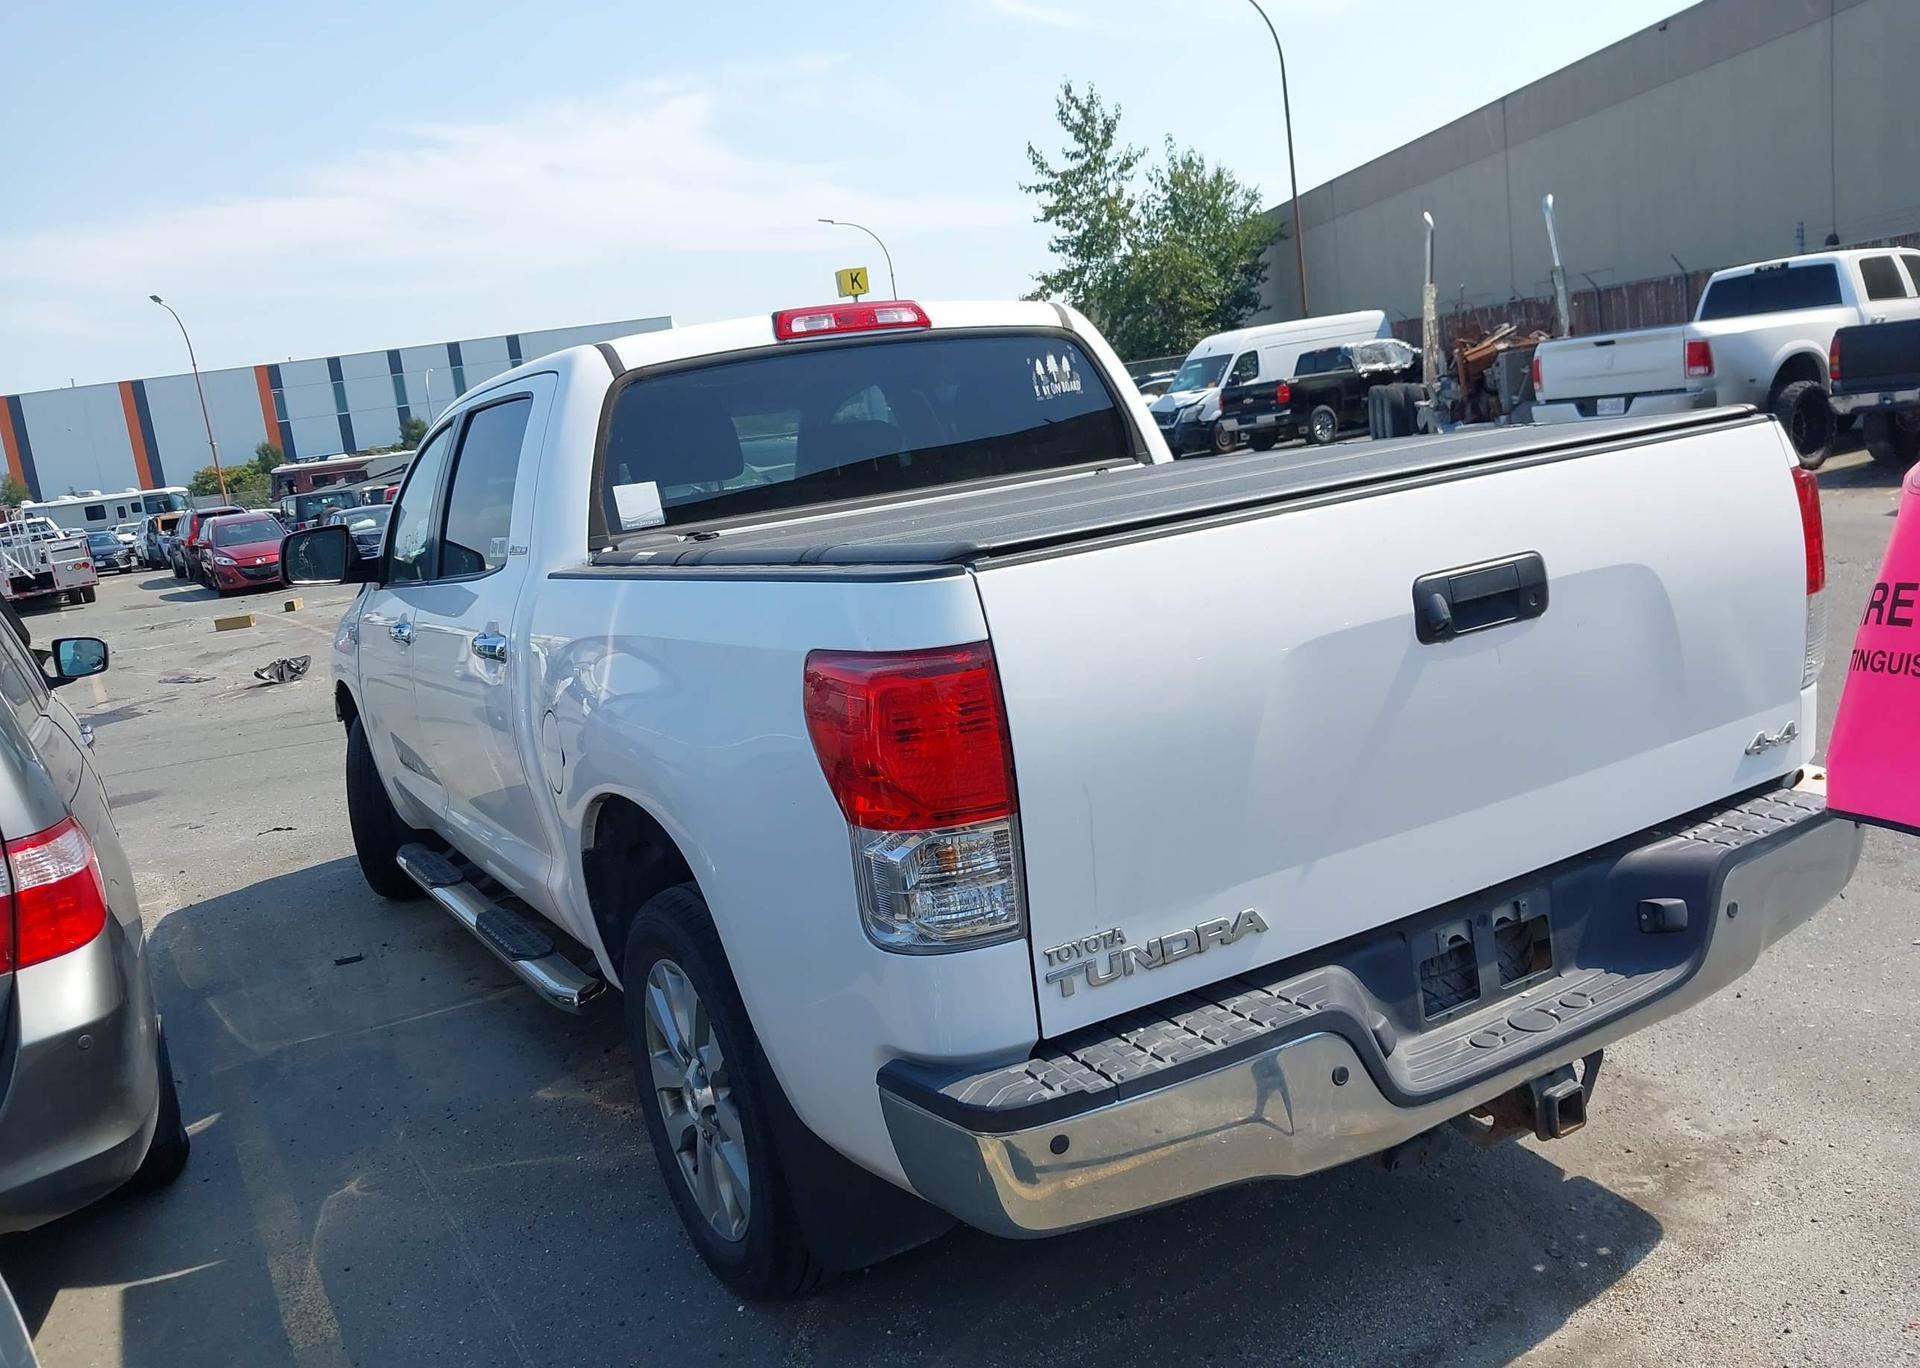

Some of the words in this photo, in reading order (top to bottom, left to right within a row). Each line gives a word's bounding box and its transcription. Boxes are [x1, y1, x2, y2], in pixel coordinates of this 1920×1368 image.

[850, 271, 863, 290] K
[1043, 927, 1127, 967] TOYOTA
[1045, 907, 1270, 998] TUNDRA
